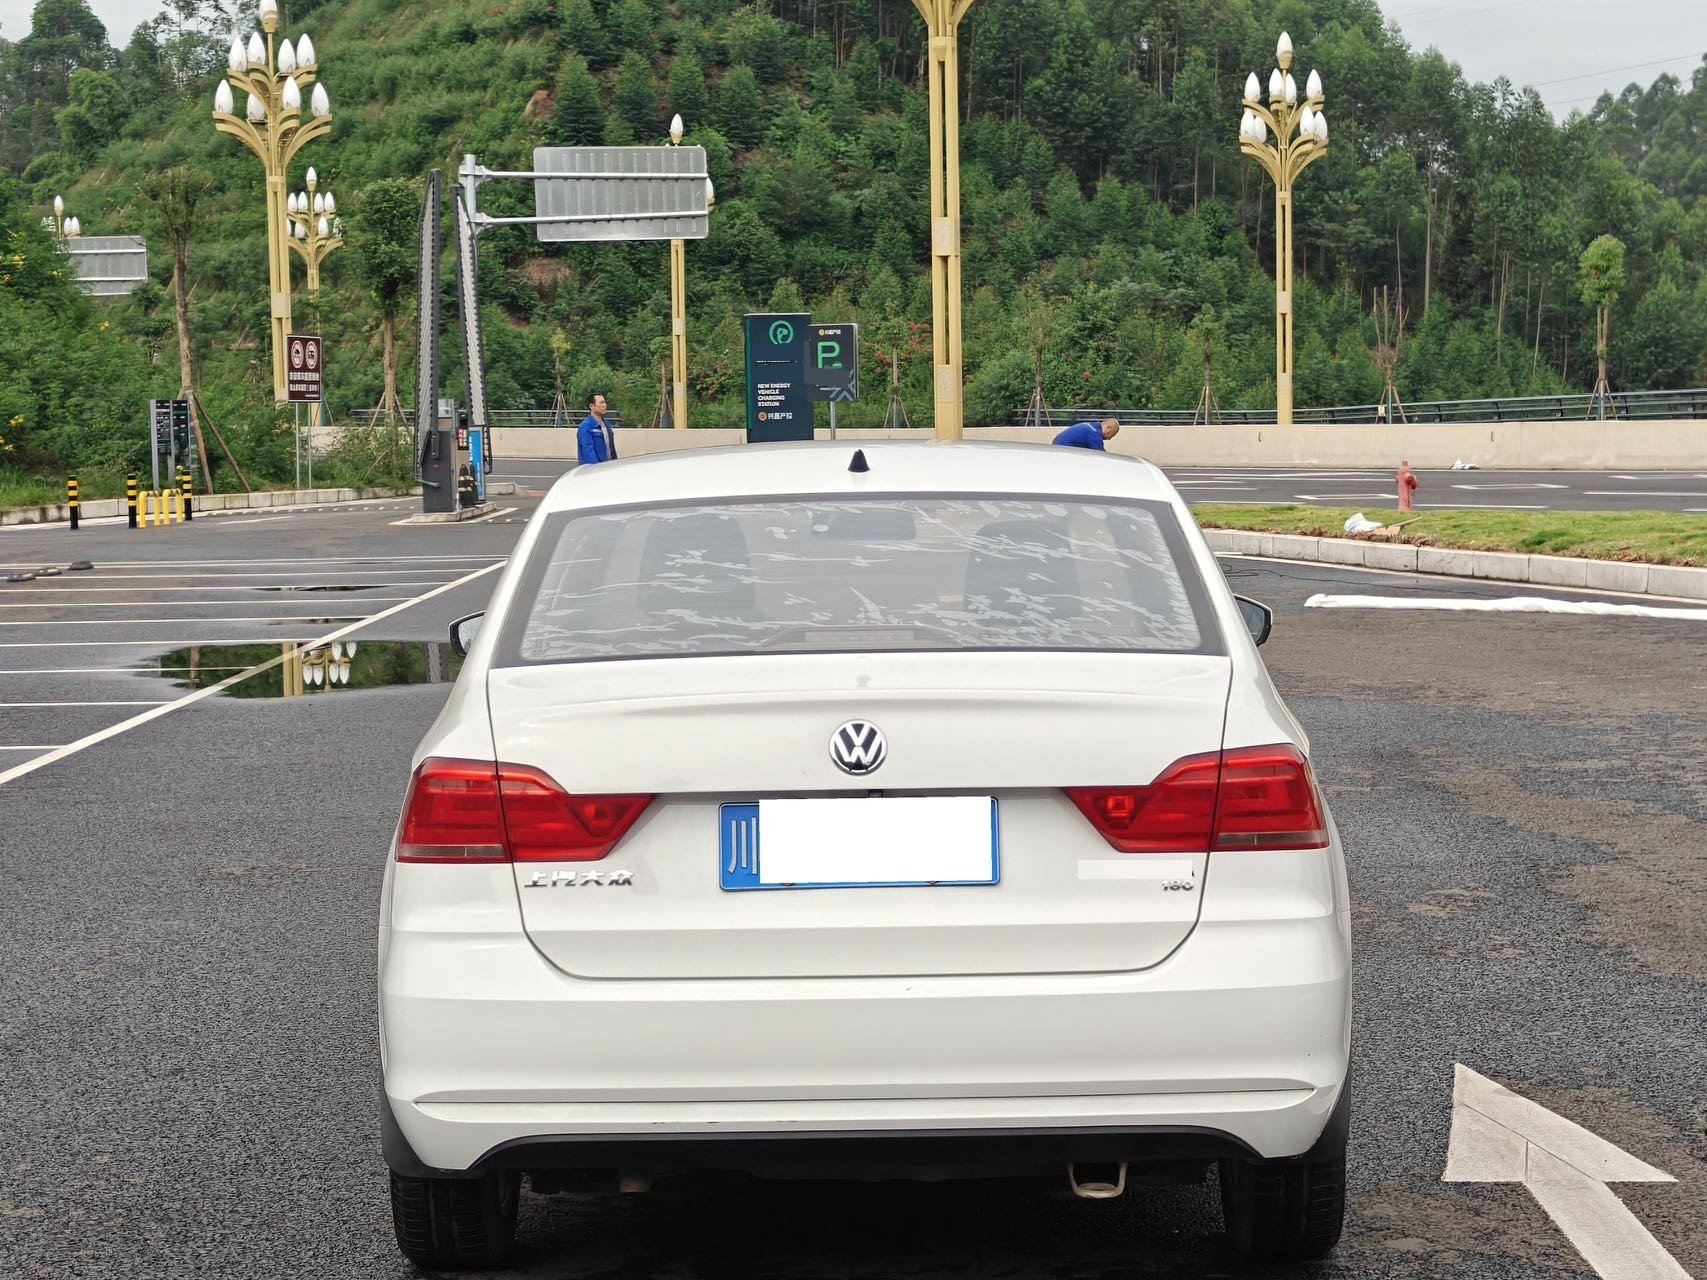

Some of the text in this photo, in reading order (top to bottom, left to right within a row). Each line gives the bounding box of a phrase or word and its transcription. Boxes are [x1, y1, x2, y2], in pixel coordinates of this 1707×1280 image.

[817, 341, 840, 369] P
[524, 868, 634, 888] 上汽大众
